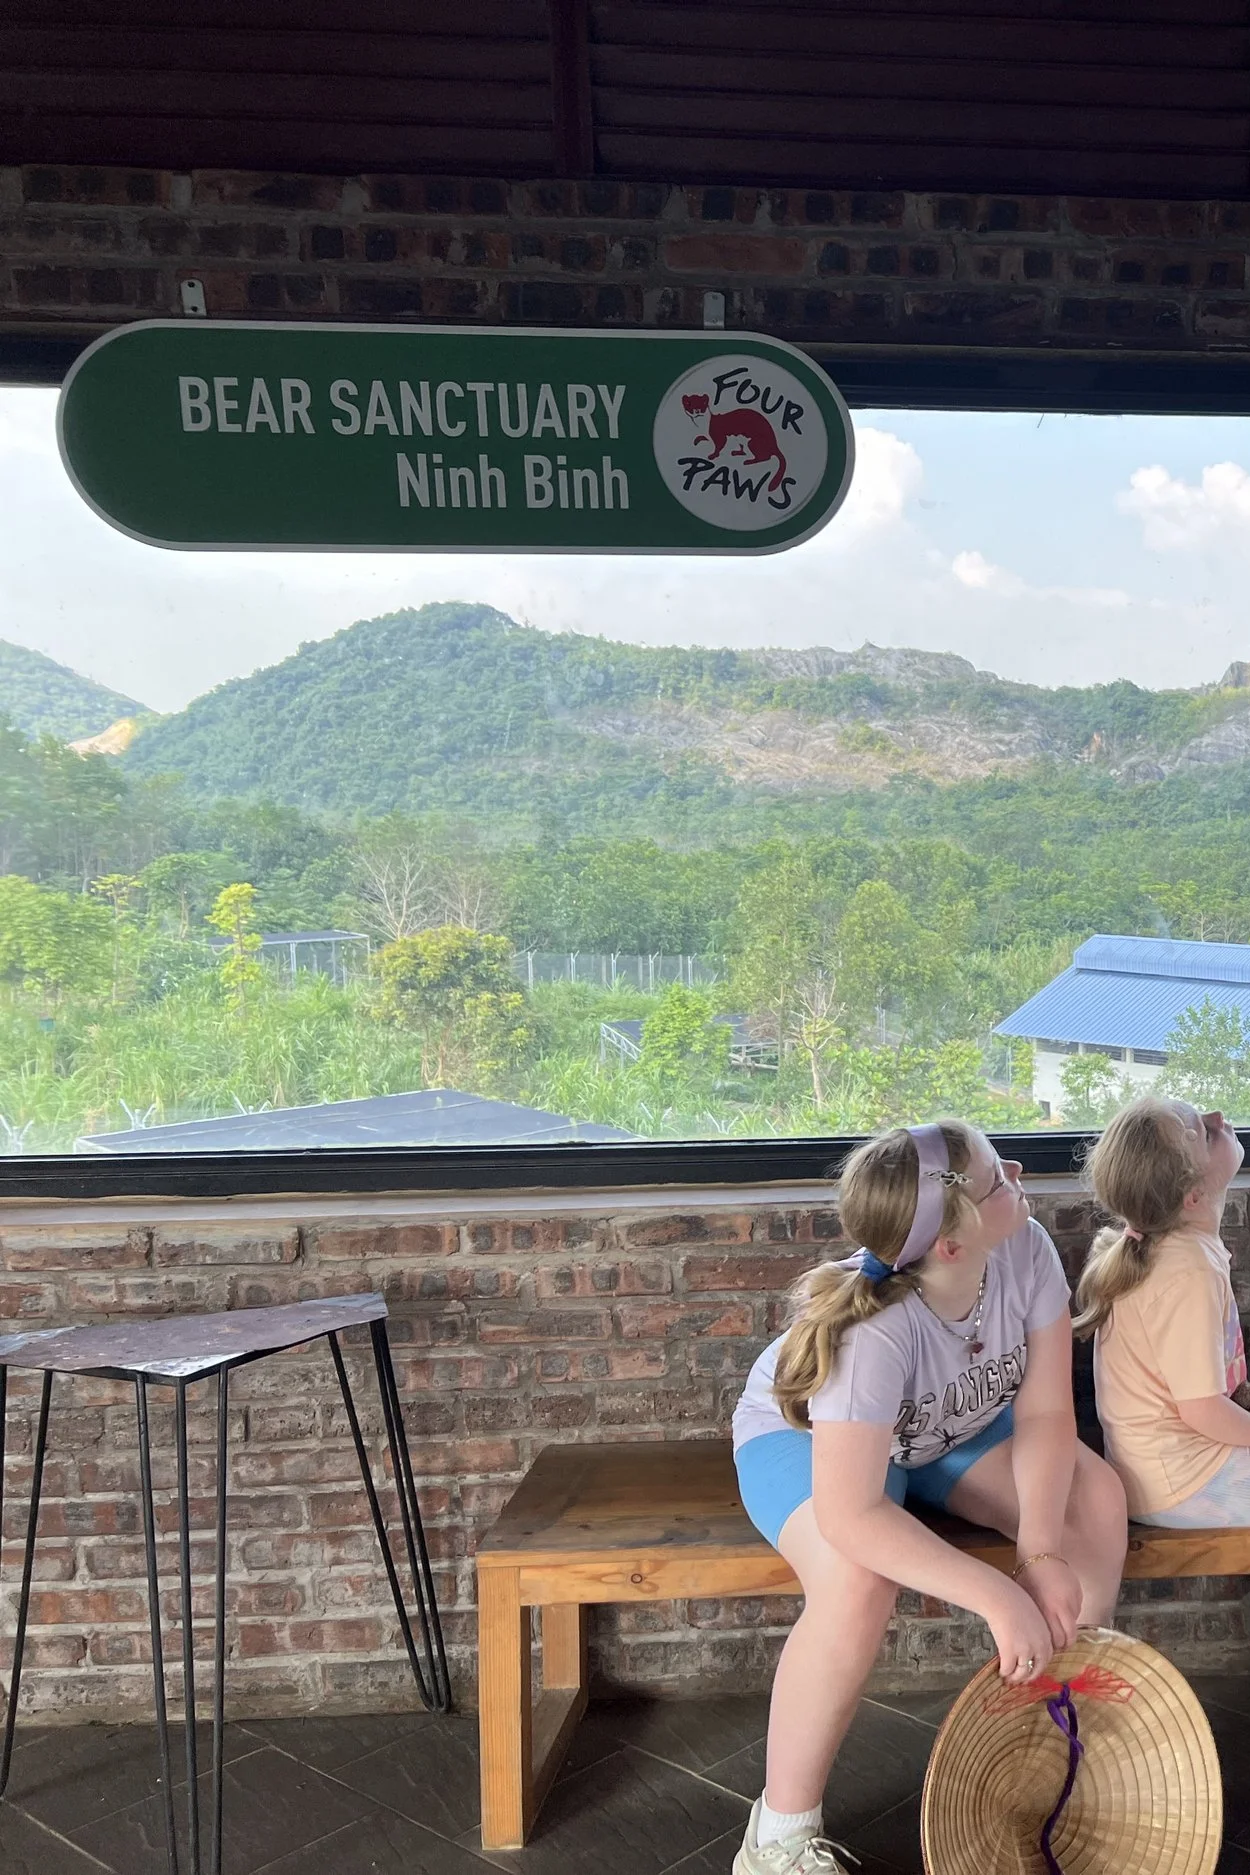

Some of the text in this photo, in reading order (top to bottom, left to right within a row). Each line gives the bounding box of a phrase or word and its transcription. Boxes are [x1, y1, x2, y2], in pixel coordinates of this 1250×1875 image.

[178, 375, 626, 439] BEAR SANCTUARY
[712, 367, 804, 435] FOUR
[396, 452, 630, 509] Ninh Binh
[677, 457, 797, 510] PAWS
